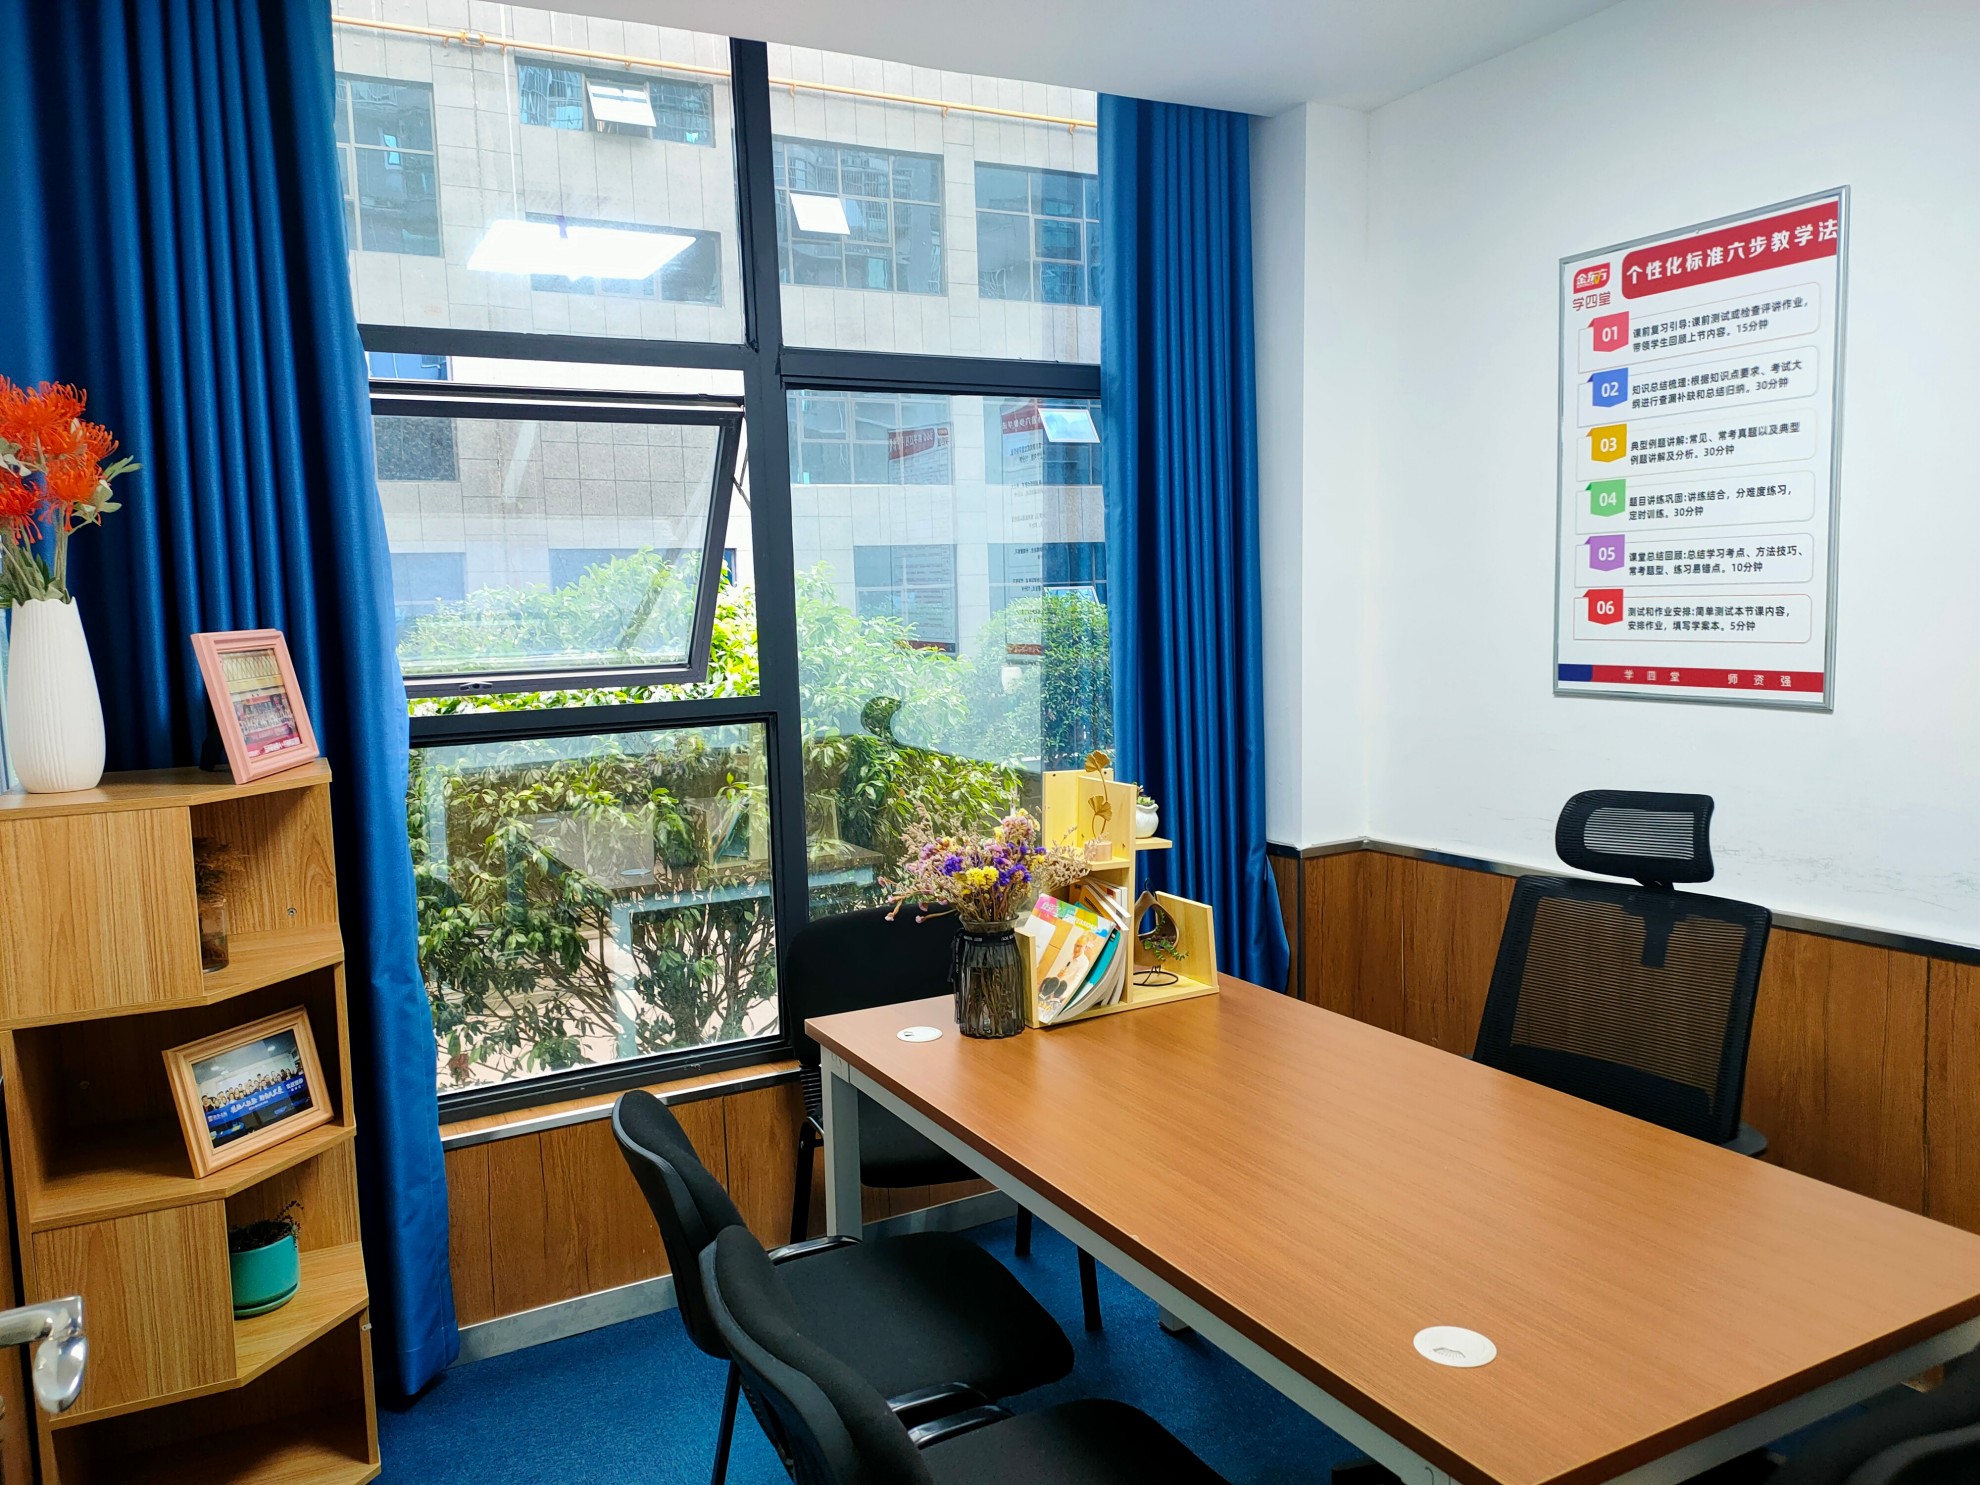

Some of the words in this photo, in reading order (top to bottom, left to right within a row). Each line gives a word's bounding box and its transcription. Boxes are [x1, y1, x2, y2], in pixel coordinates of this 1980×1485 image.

[1626, 219, 1838, 285] 个性化标准六步教学法
[1572, 291, 1611, 311] 学四堂
[1602, 327, 1618, 342] 01
[1601, 382, 1619, 398] 02
[1600, 437, 1618, 452] 03
[1599, 492, 1617, 507] 04
[1598, 546, 1616, 561] 05
[1596, 600, 1615, 615] 06
[1727, 673, 1792, 687] 师资强
